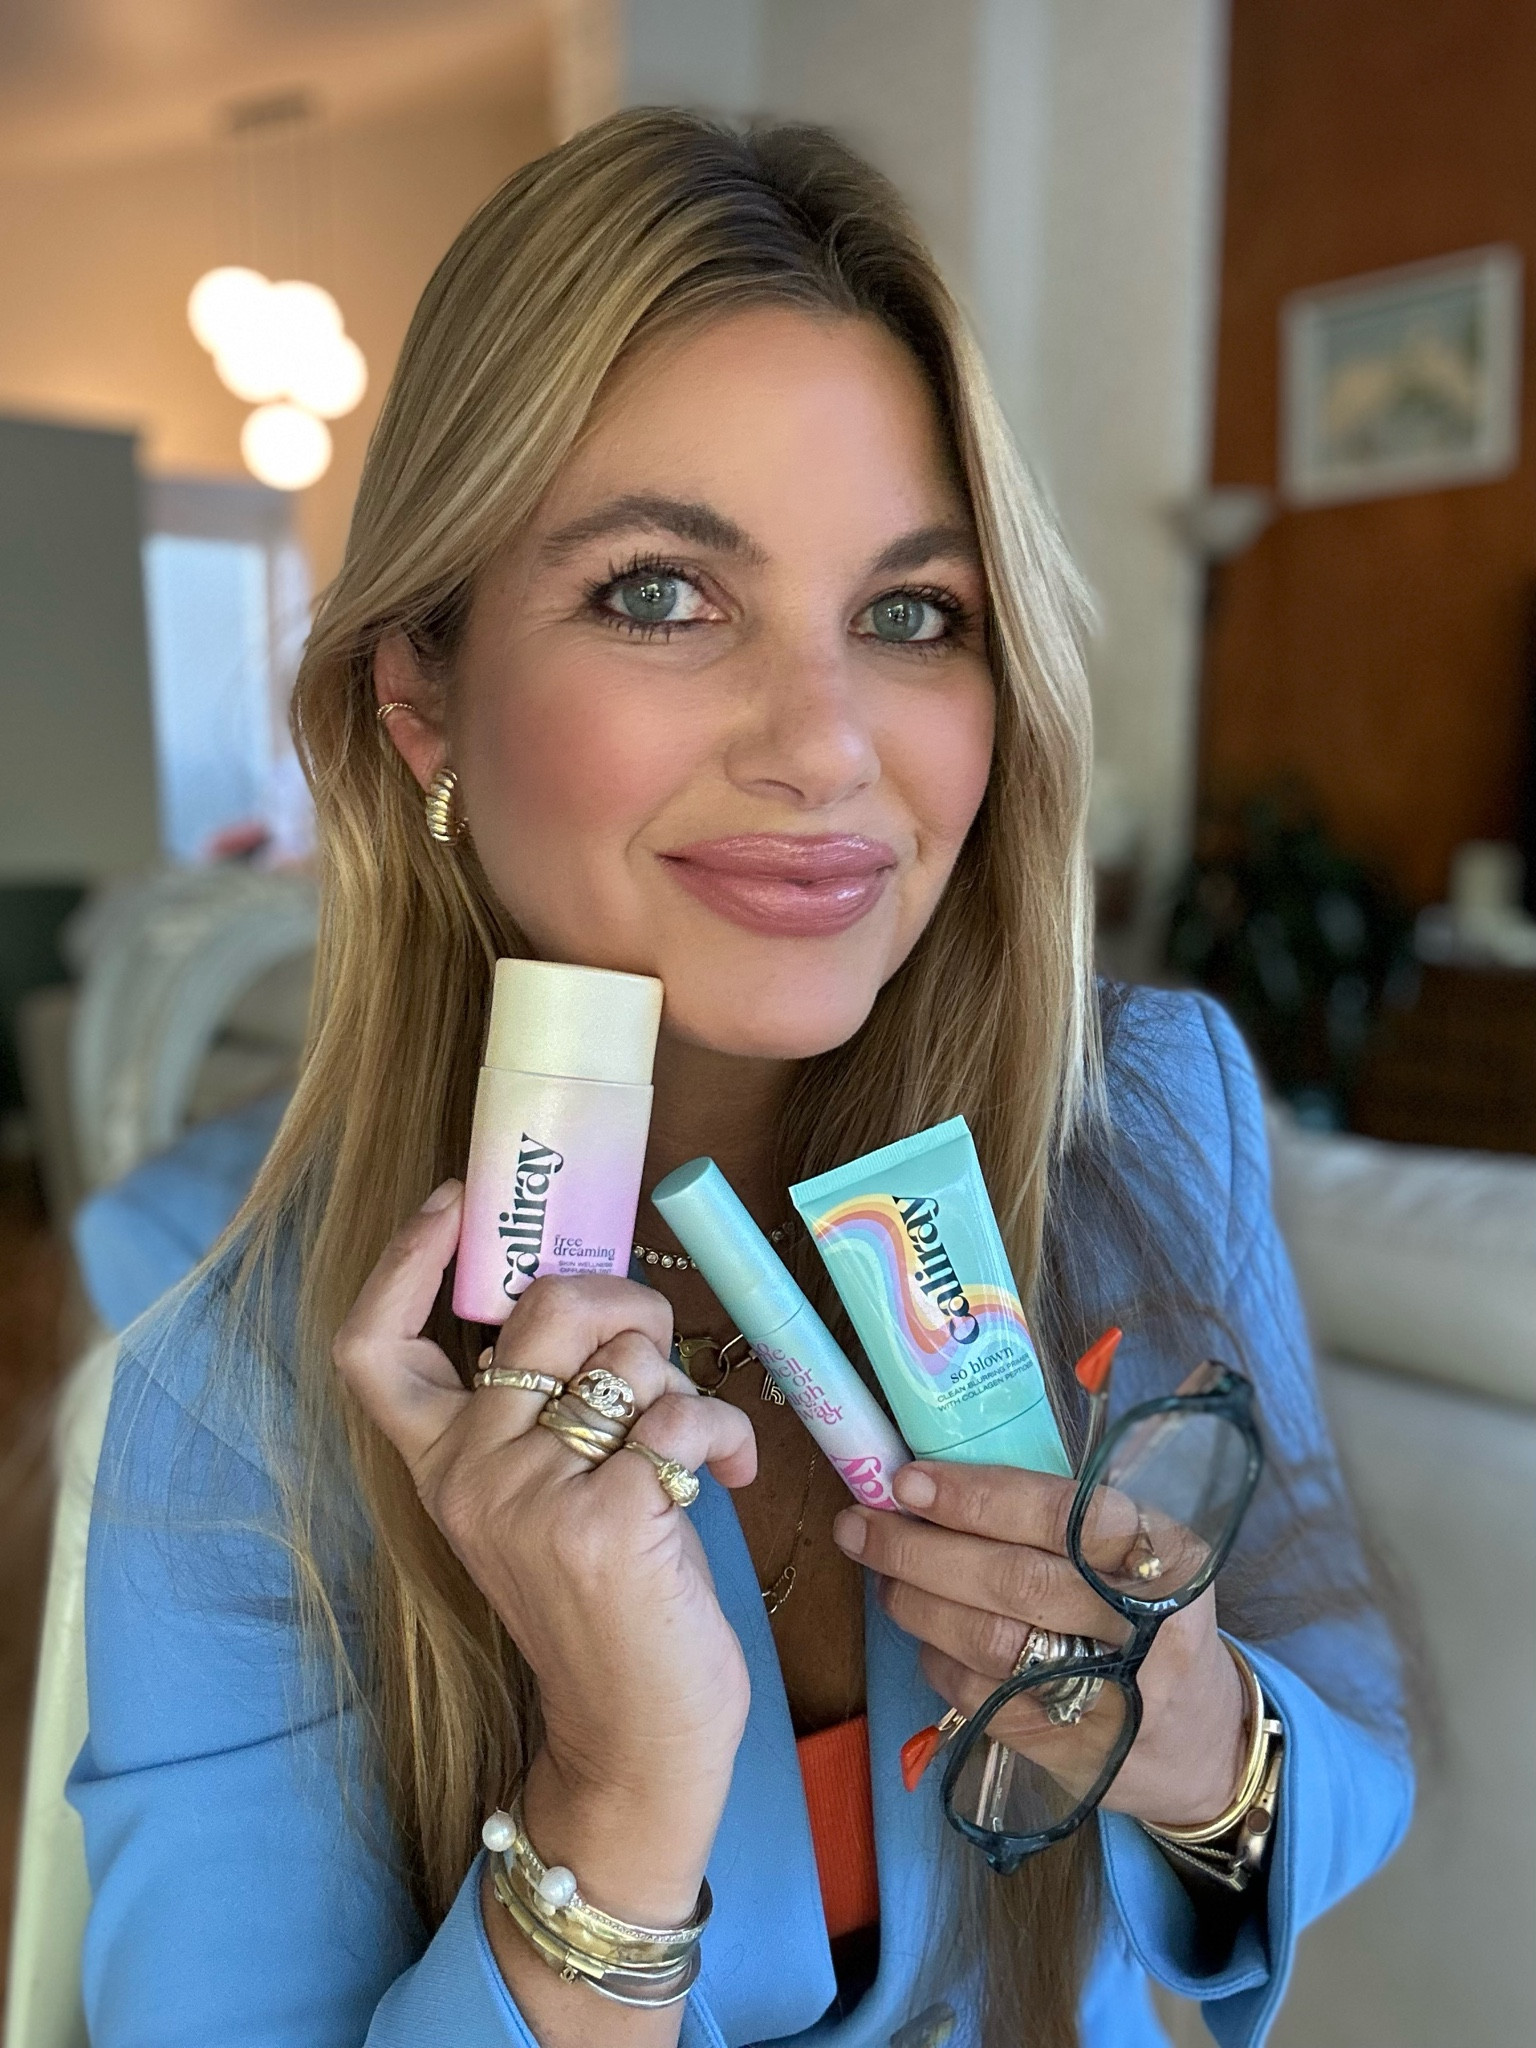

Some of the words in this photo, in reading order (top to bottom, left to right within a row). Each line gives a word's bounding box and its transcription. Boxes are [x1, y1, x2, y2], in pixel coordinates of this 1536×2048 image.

[553, 1245, 615, 1261] dreaming
[554, 1234, 583, 1247] free
[892, 1195, 980, 1345] caliray
[793, 1368, 813, 1387] or
[937, 1385, 966, 1403] CLEAN
[967, 1367, 1006, 1389] BLURRING
[1006, 1352, 1030, 1369] PRIMER
[950, 1368, 968, 1384] so
[968, 1346, 1014, 1375] blown
[937, 1398, 961, 1412] WITH
[961, 1376, 1005, 1402] COLLAGEN
